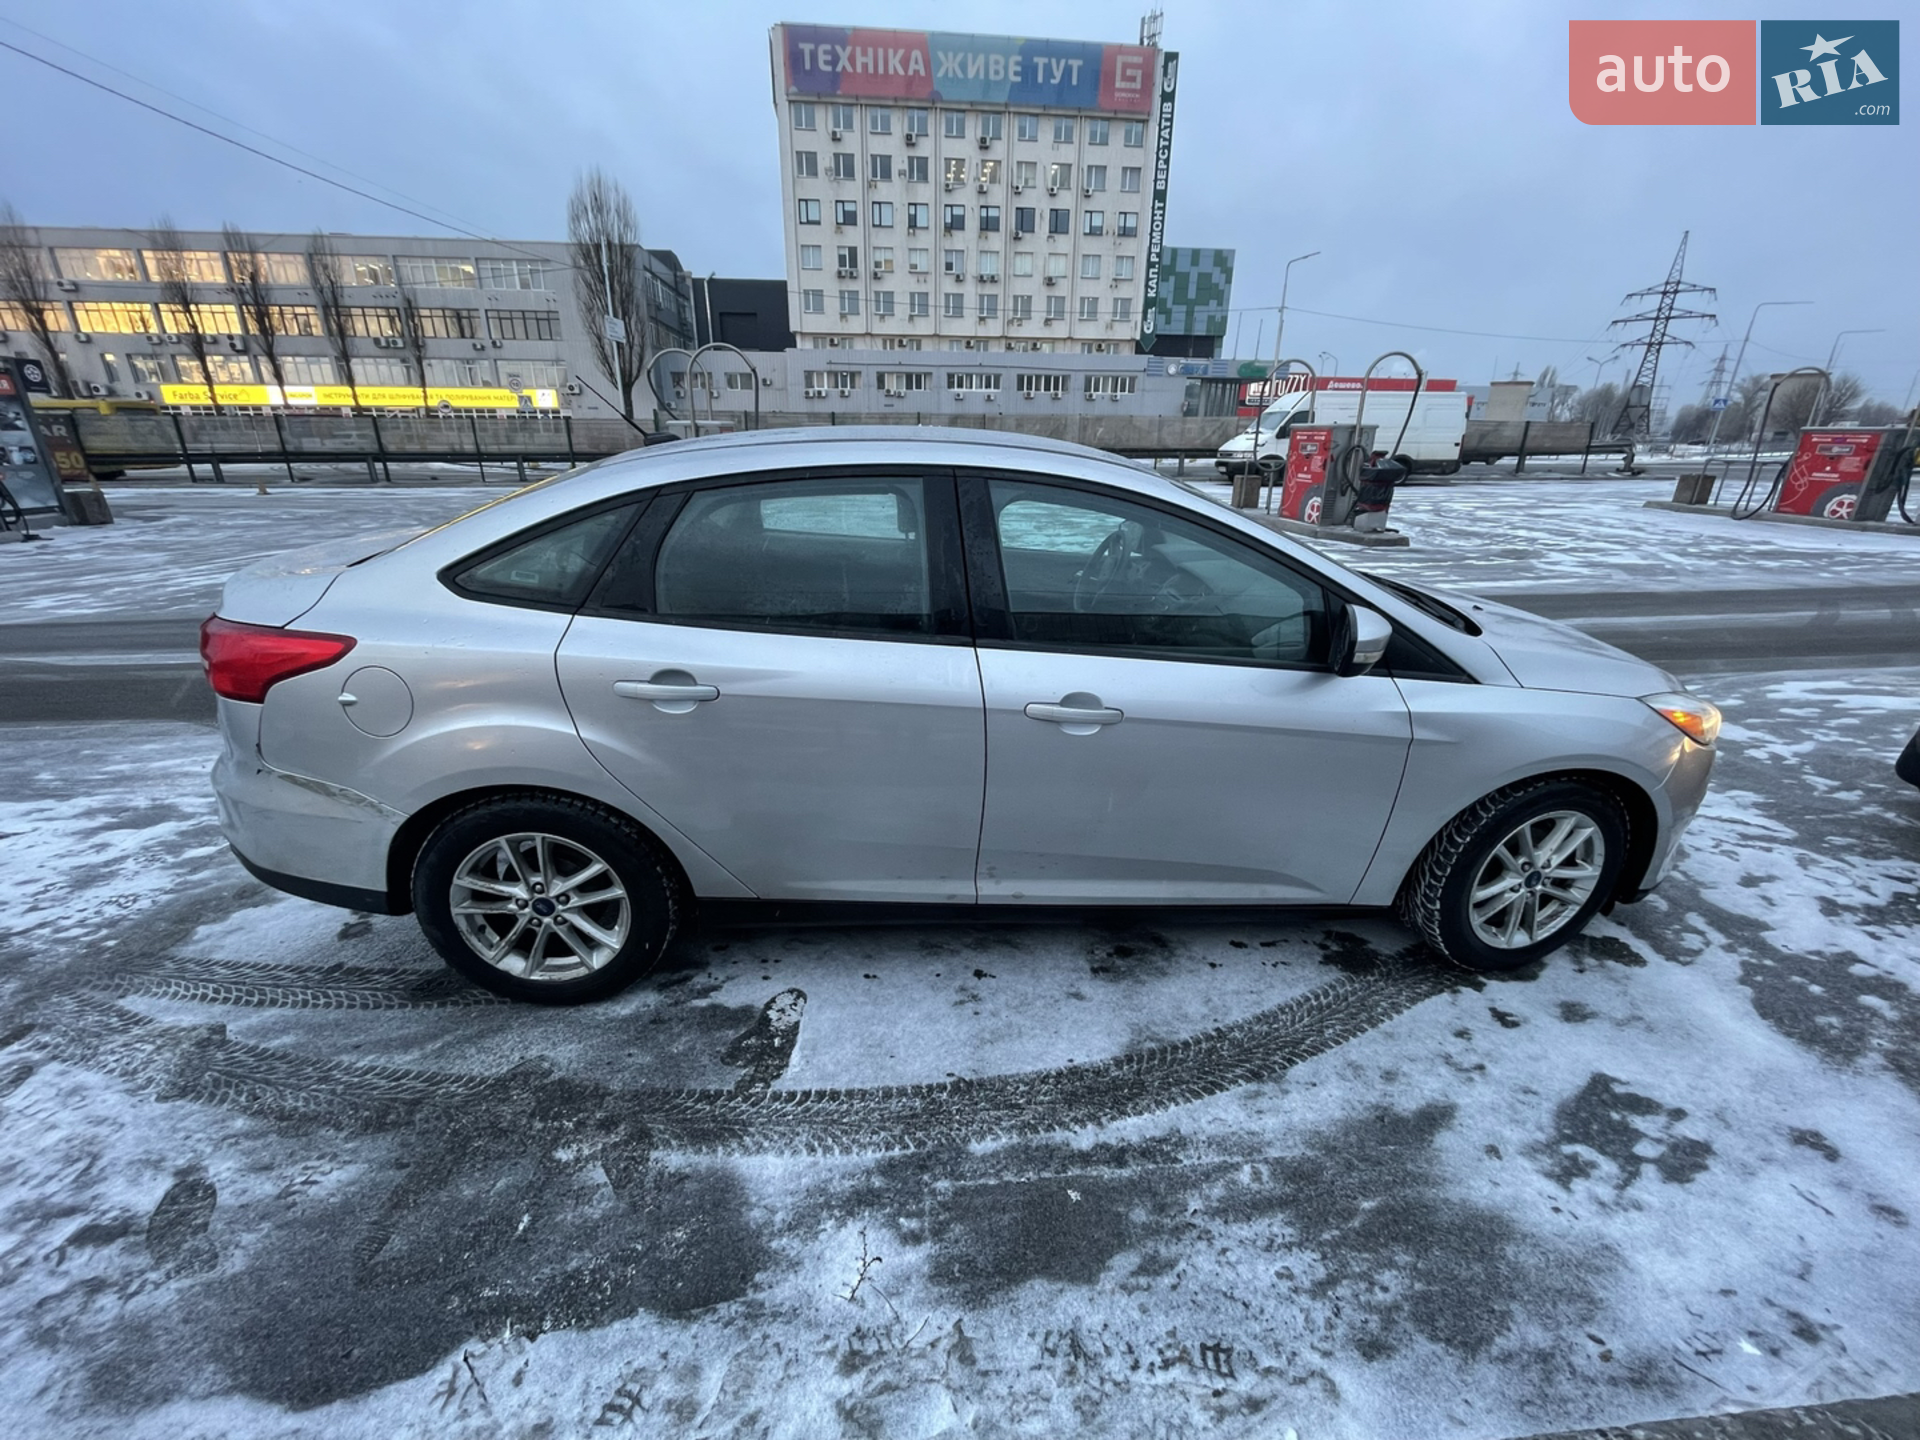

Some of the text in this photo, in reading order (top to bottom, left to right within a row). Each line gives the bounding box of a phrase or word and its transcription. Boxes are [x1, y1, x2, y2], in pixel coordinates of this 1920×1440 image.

[798, 43, 1084, 86] ТЕХНІКА ЖИВЕ ТУТ
[1156, 102, 1172, 190] ВЕРСТАТІВ
[1150, 200, 1164, 262] РЕМОНТ
[1147, 264, 1159, 297] КАП.
[172, 390, 238, 400] Farba Svice
